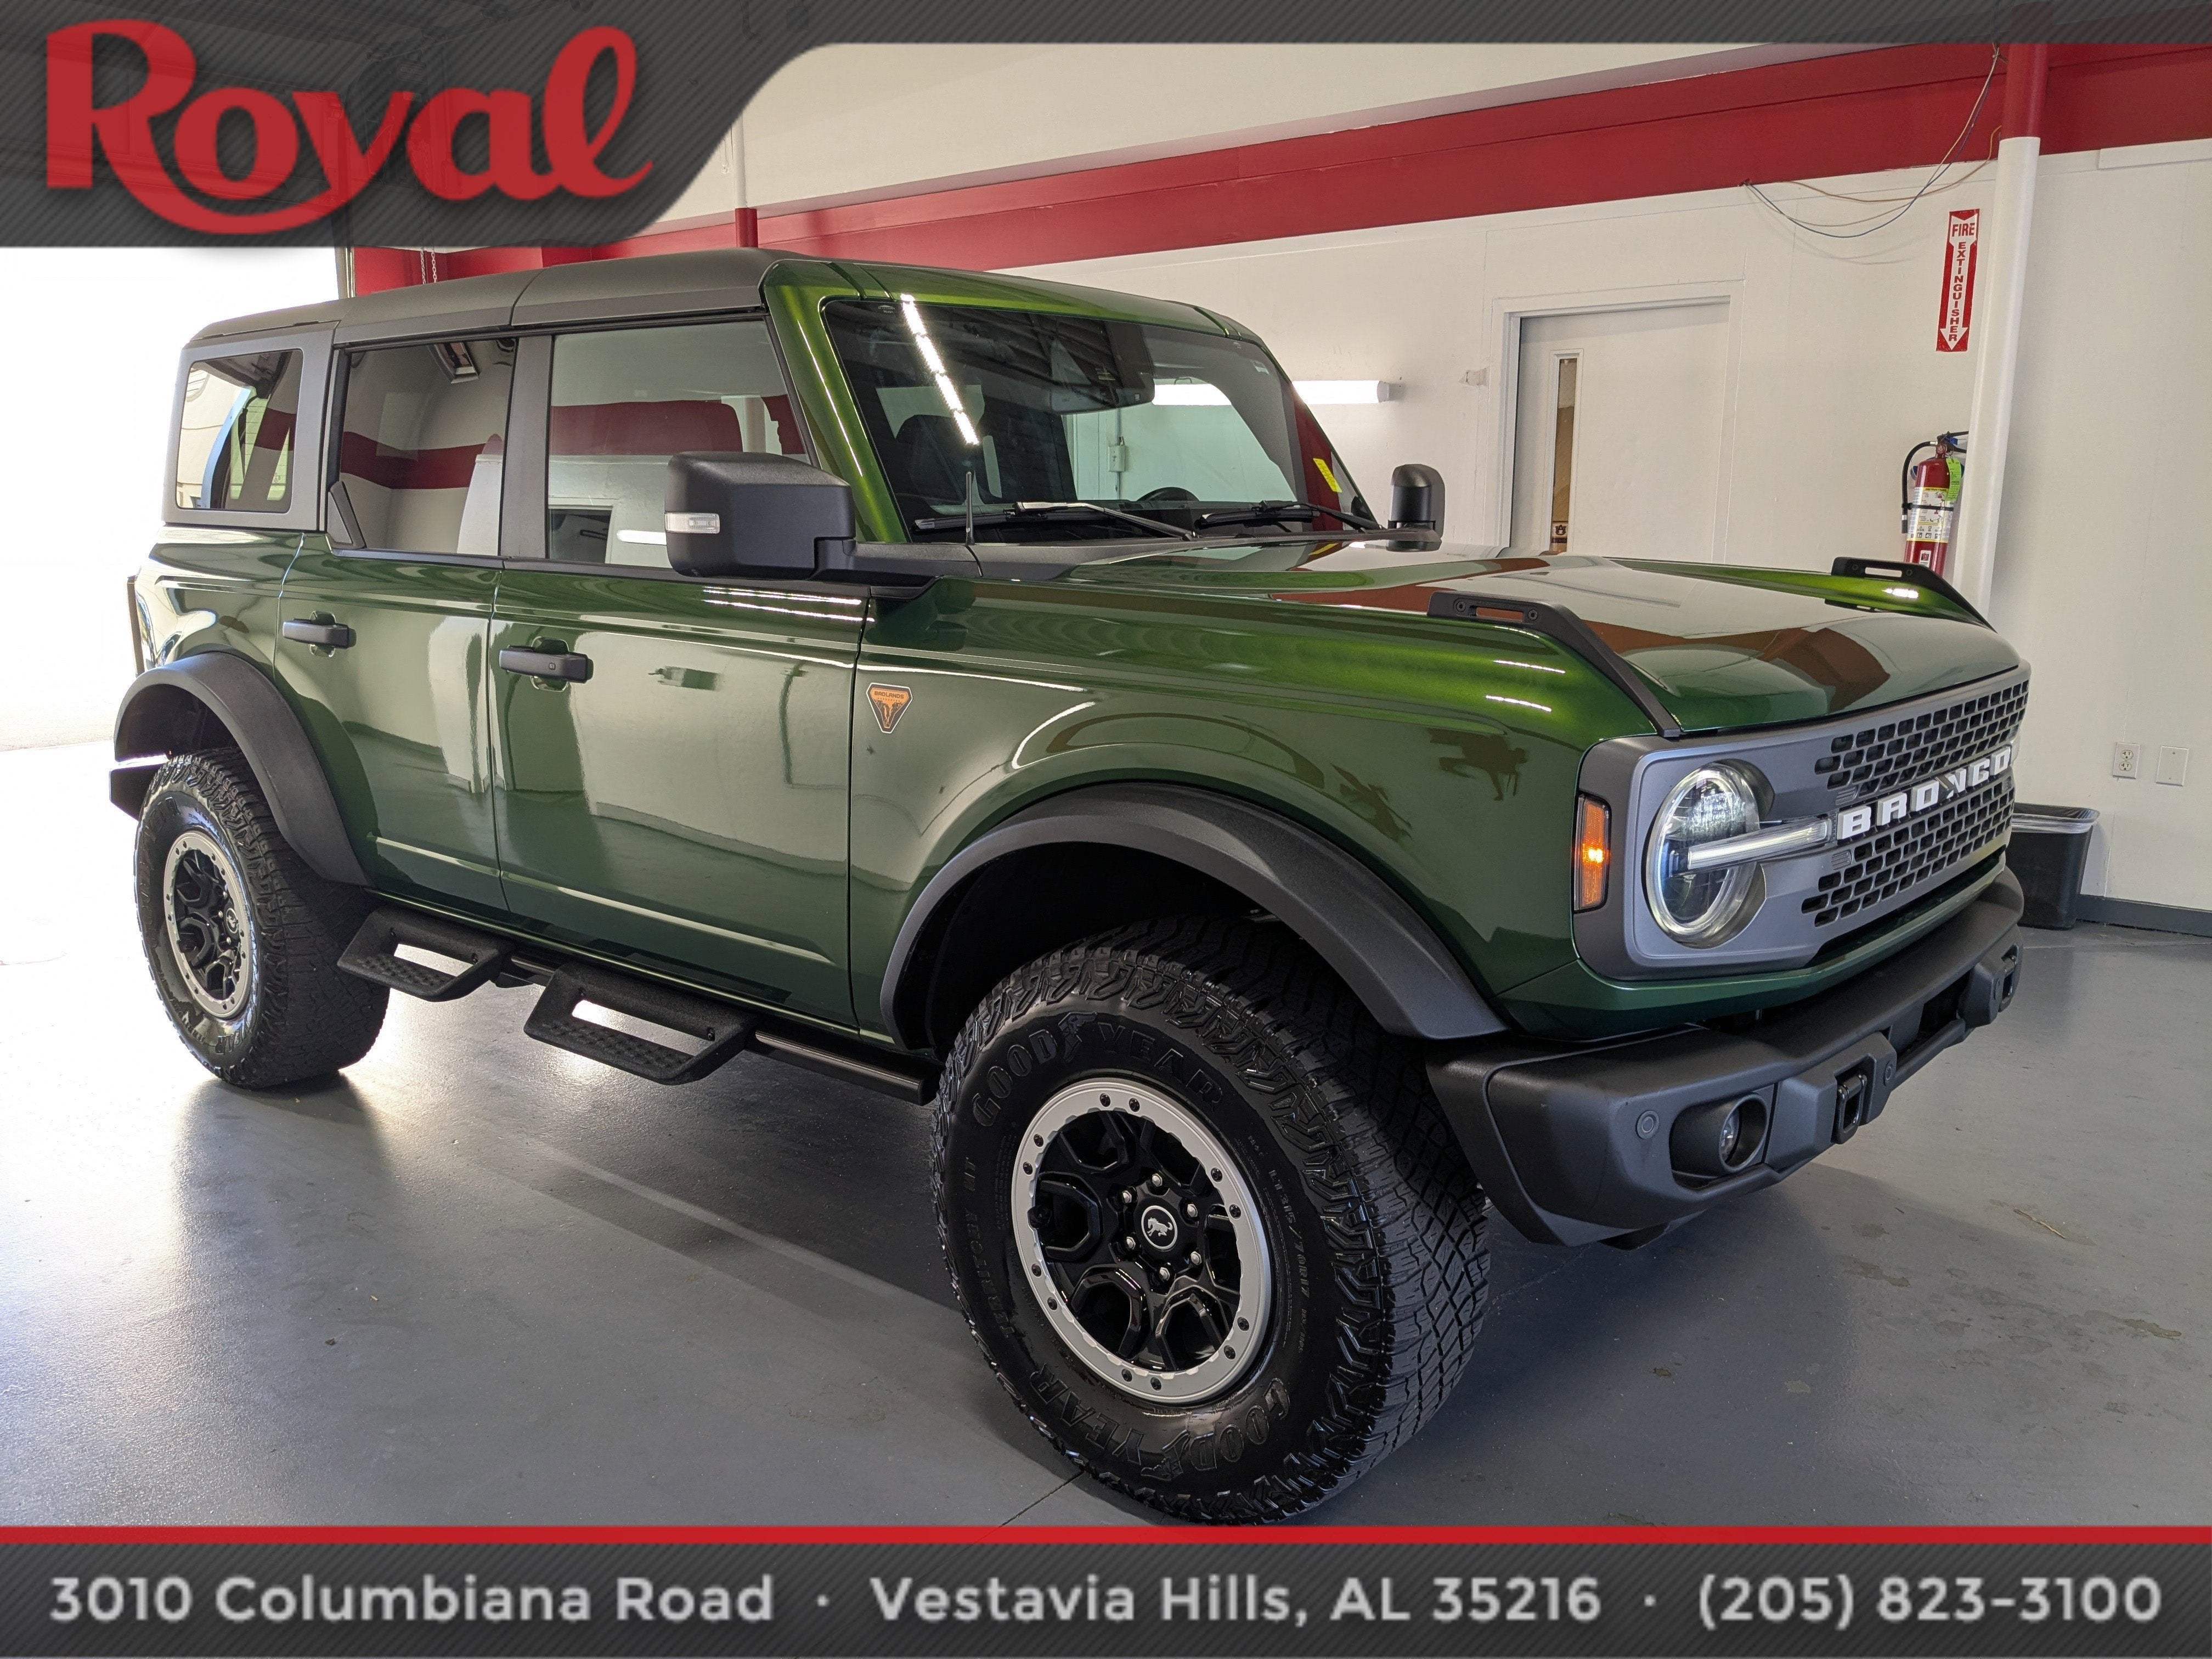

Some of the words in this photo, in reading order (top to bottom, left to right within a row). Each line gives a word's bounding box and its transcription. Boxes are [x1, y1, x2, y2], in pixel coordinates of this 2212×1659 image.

[1951, 222, 1975, 238] FIRE
[1948, 241, 1967, 342] EXTINGUISHER
[874, 691, 905, 699] BADLANDS
[1837, 747, 2012, 839] BRONCO
